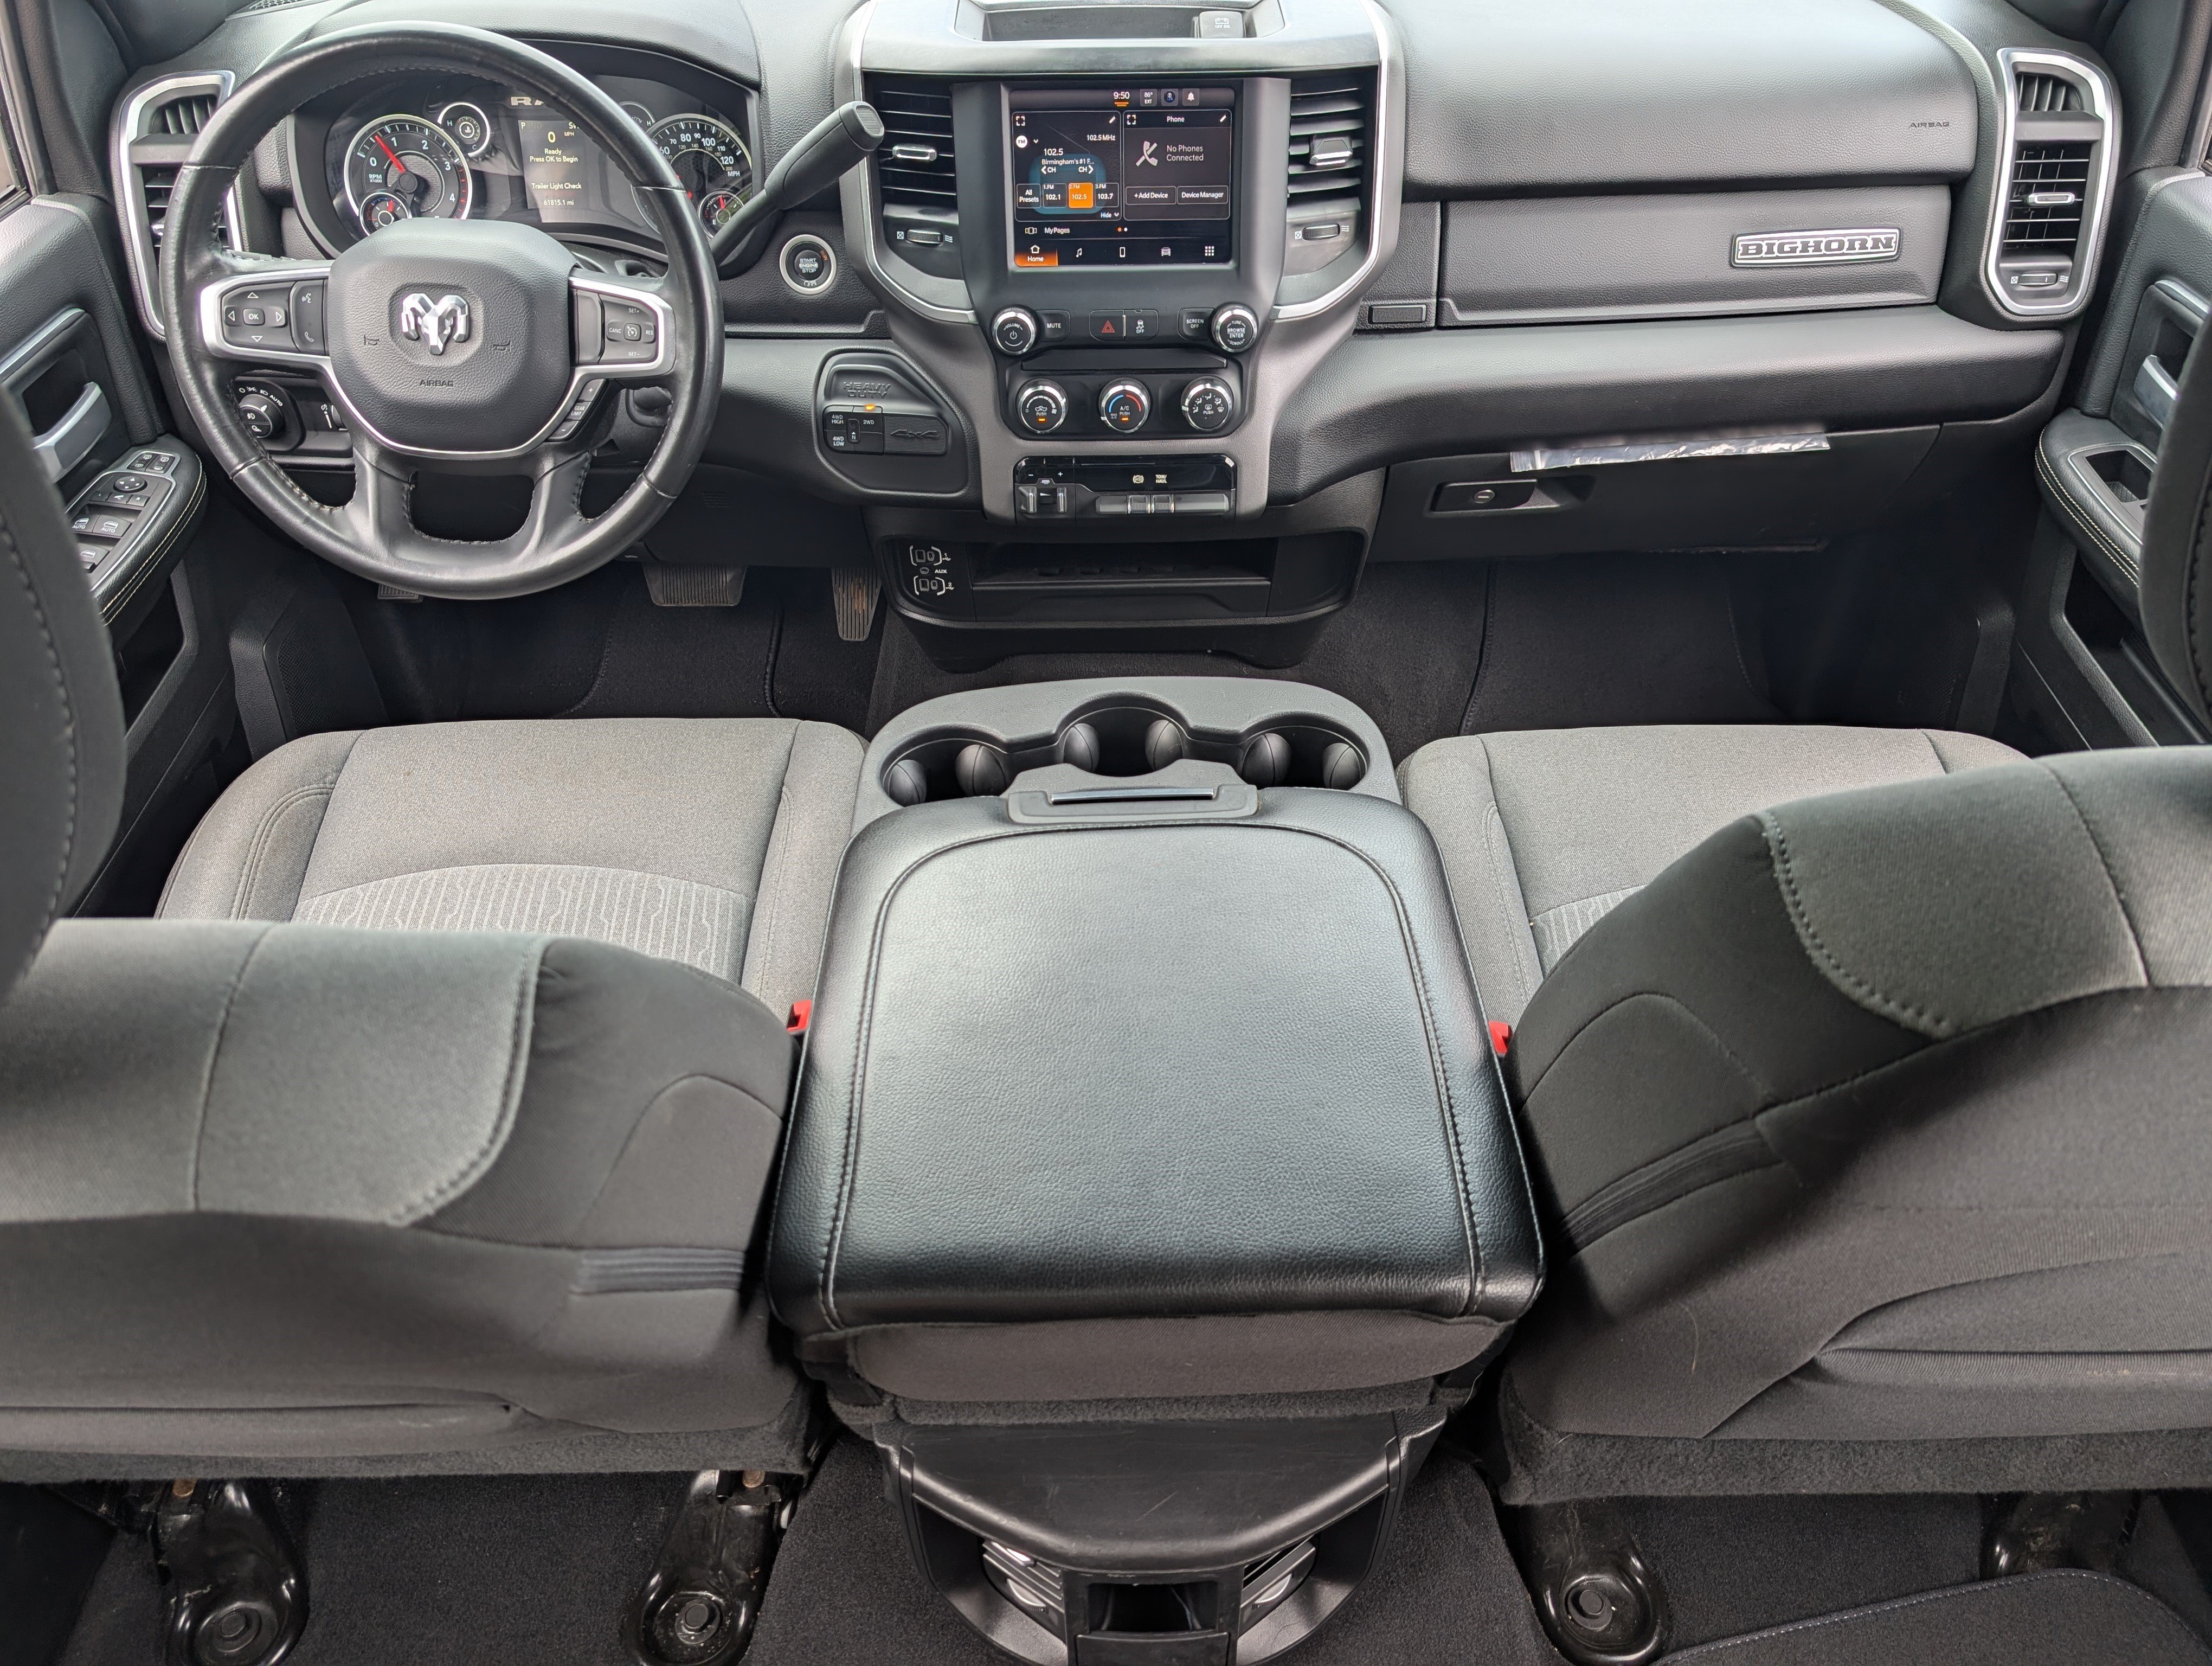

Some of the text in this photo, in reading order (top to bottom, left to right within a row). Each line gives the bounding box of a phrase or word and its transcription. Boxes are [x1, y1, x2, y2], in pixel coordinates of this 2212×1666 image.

[391, 137, 397, 146] 1
[548, 131, 556, 143] 0
[680, 133, 691, 142] 80
[422, 140, 428, 150] 2
[702, 138, 716, 146] 100
[370, 157, 377, 166] 0
[721, 156, 734, 164] 120
[445, 161, 451, 170] 3
[449, 193, 455, 202] 4
[1740, 236, 1894, 257] BIGHORN
[844, 382, 891, 392] HEAVY
[847, 390, 887, 399] DUTY
[270, 395, 283, 407] AUTO
